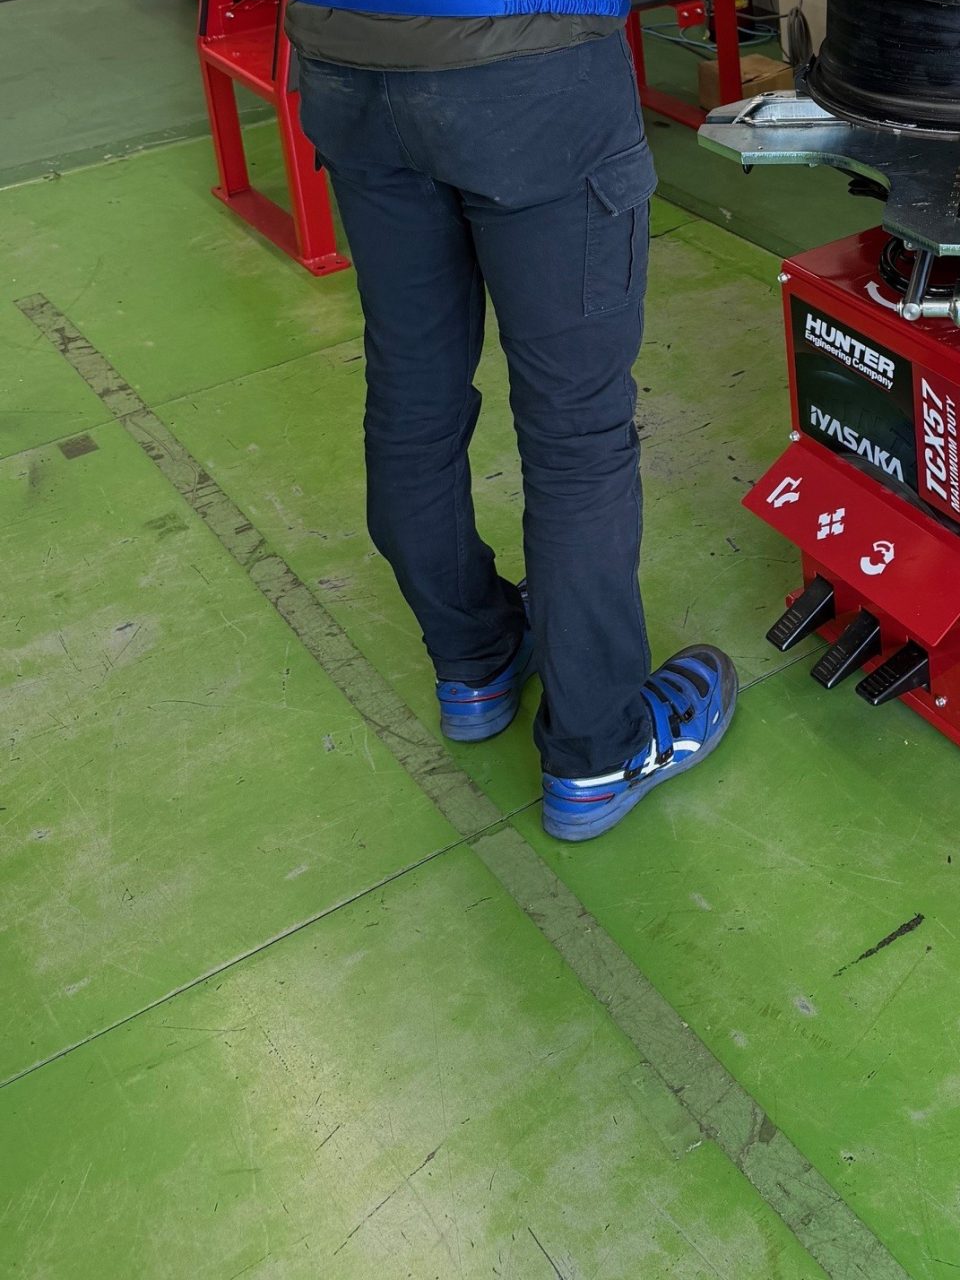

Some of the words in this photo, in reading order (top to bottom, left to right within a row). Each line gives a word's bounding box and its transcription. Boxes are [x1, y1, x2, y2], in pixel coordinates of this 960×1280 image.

[805, 330, 851, 366] Engineering
[852, 358, 893, 390] Company
[806, 313, 895, 379] HUNTER
[810, 404, 905, 483] IYASAKA
[921, 377, 948, 500] TCX57
[946, 394, 957, 437] DUTY
[948, 437, 960, 513] MAXIMUM
